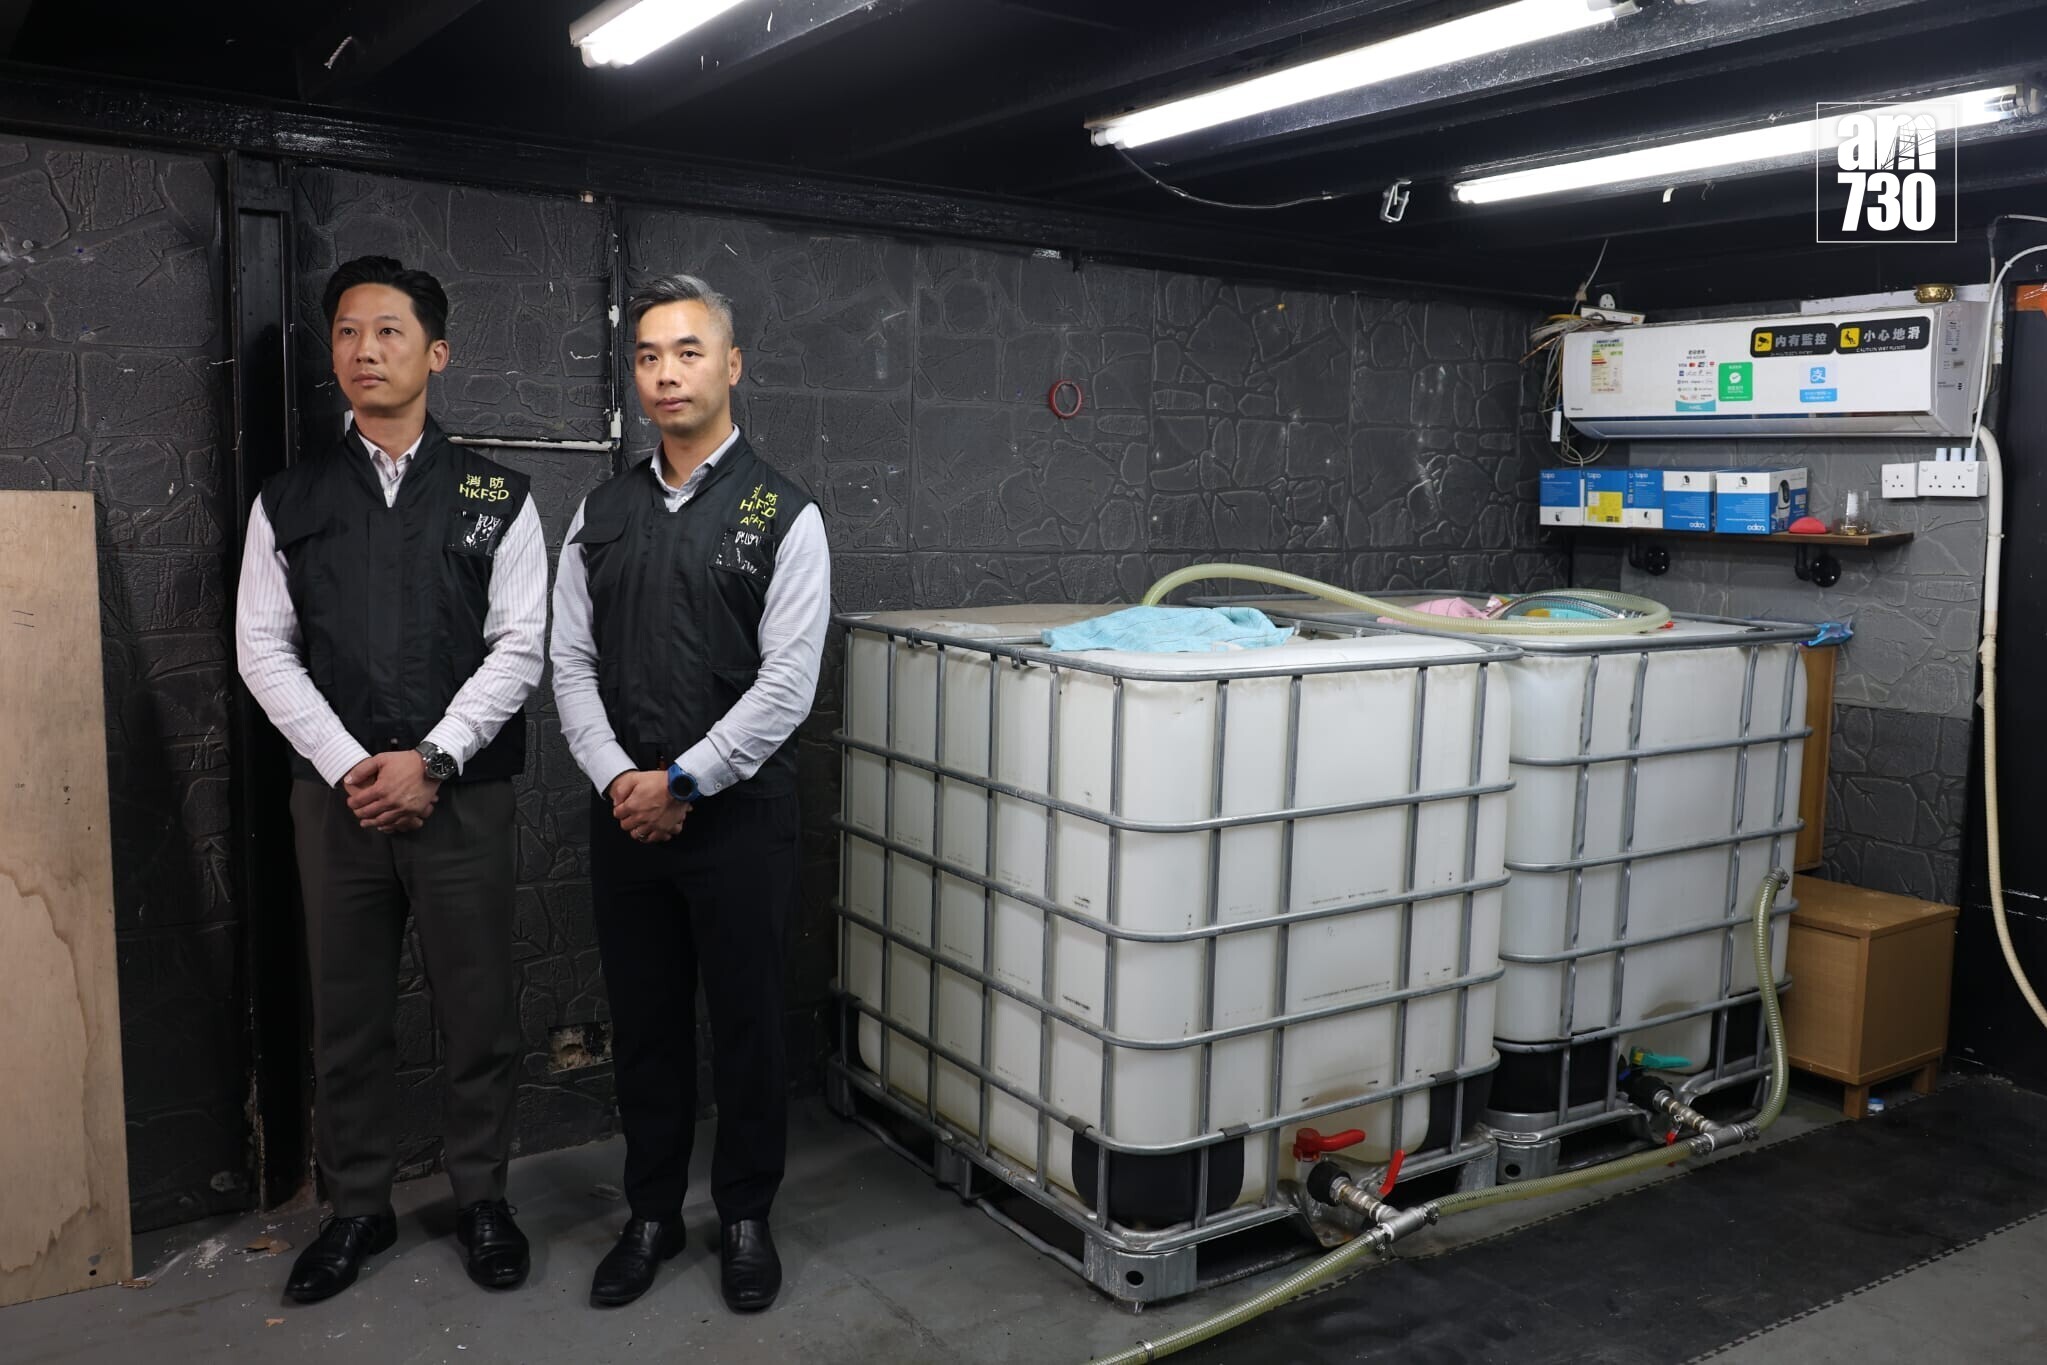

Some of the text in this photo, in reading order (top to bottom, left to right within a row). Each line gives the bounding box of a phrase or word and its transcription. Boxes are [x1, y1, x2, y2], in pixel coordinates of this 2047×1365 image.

[1864, 325, 1921, 343] 小心地滑
[465, 473, 505, 489] 消防
[459, 483, 510, 502] HKFSD
